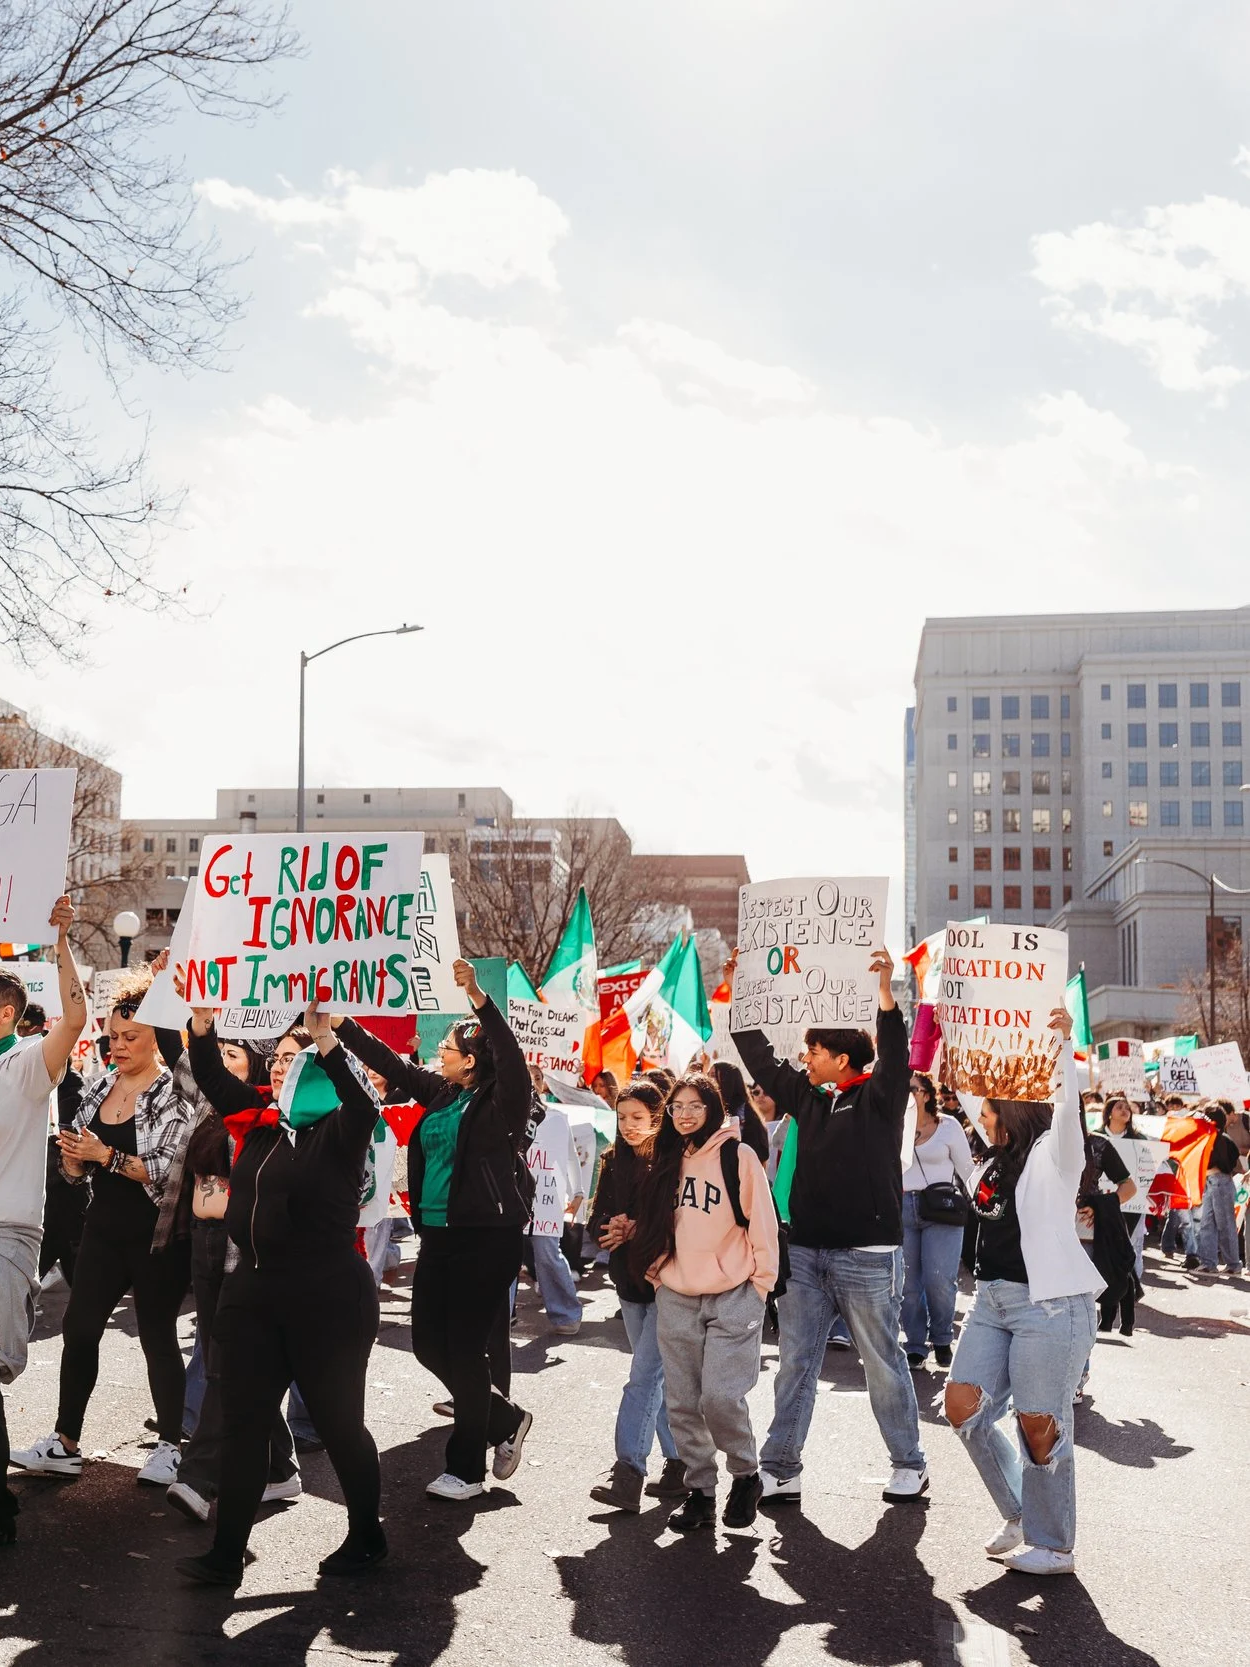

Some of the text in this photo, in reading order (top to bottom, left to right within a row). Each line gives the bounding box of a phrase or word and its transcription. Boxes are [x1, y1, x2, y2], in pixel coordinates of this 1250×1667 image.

[204, 844, 254, 898] Get
[334, 843, 388, 891] OF
[740, 891, 807, 921] RESPECT
[243, 893, 414, 951] IGNORANCE
[738, 917, 874, 955] EXISTENCE
[946, 929, 1039, 951] OOL IS
[767, 946, 801, 975] OR
[942, 957, 1046, 982] DUCATION
[185, 956, 238, 1003] NOT
[942, 980, 964, 1000] NOT
[509, 1015, 530, 1034] That
[734, 995, 873, 1030] RESISTANCE
[1162, 1080, 1198, 1092] TOGET
[544, 1175, 557, 1188] LA
[542, 1194, 554, 1206] EN
[673, 1176, 722, 1215] AP
[535, 1220, 559, 1234] NCA
